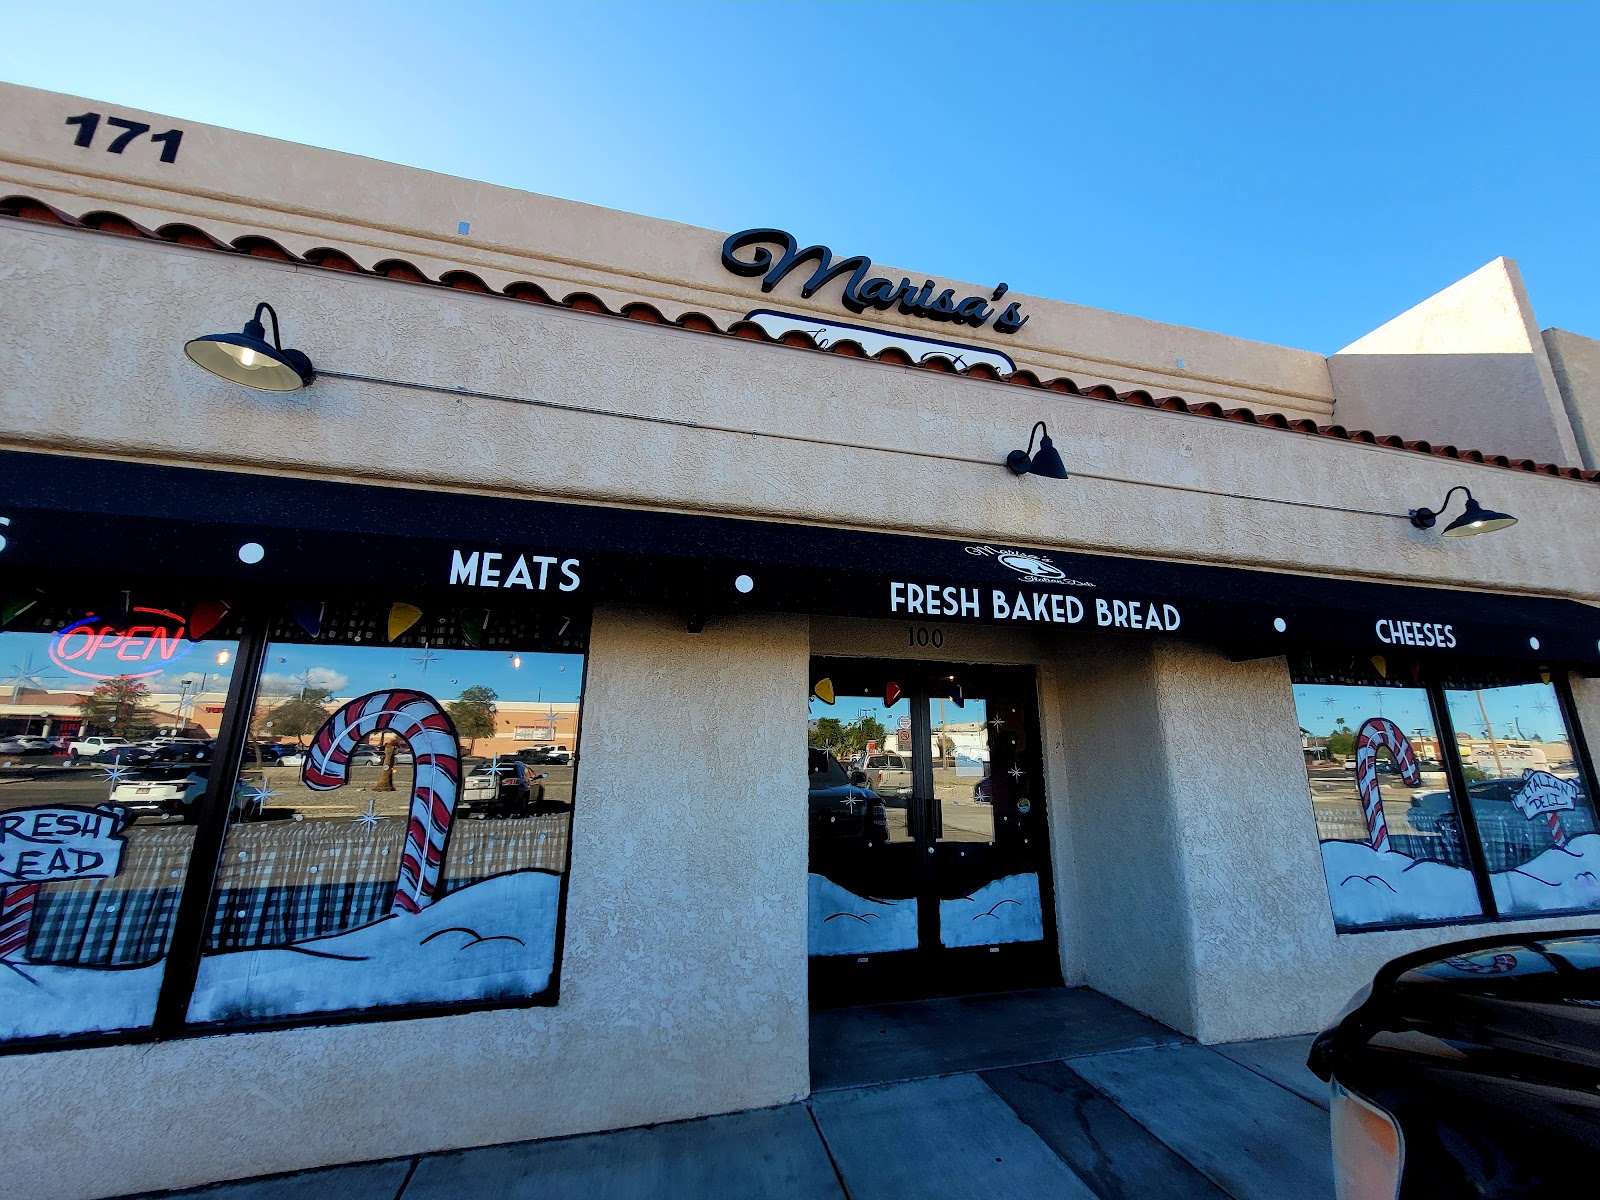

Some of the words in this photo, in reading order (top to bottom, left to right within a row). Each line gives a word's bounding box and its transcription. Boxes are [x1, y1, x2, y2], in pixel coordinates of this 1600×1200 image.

[65, 111, 184, 164] 171
[721, 228, 1030, 334] Marisa's
[449, 549, 580, 592] MEATS
[890, 582, 980, 618] FRESH
[992, 590, 1084, 624] BAKED
[1095, 598, 1181, 631] BREAD
[57, 626, 185, 661] OPEN
[908, 626, 944, 649] 100
[1375, 619, 1457, 648] CHEESES
[1522, 774, 1569, 800] ITALIAN
[1529, 793, 1568, 810] DELI
